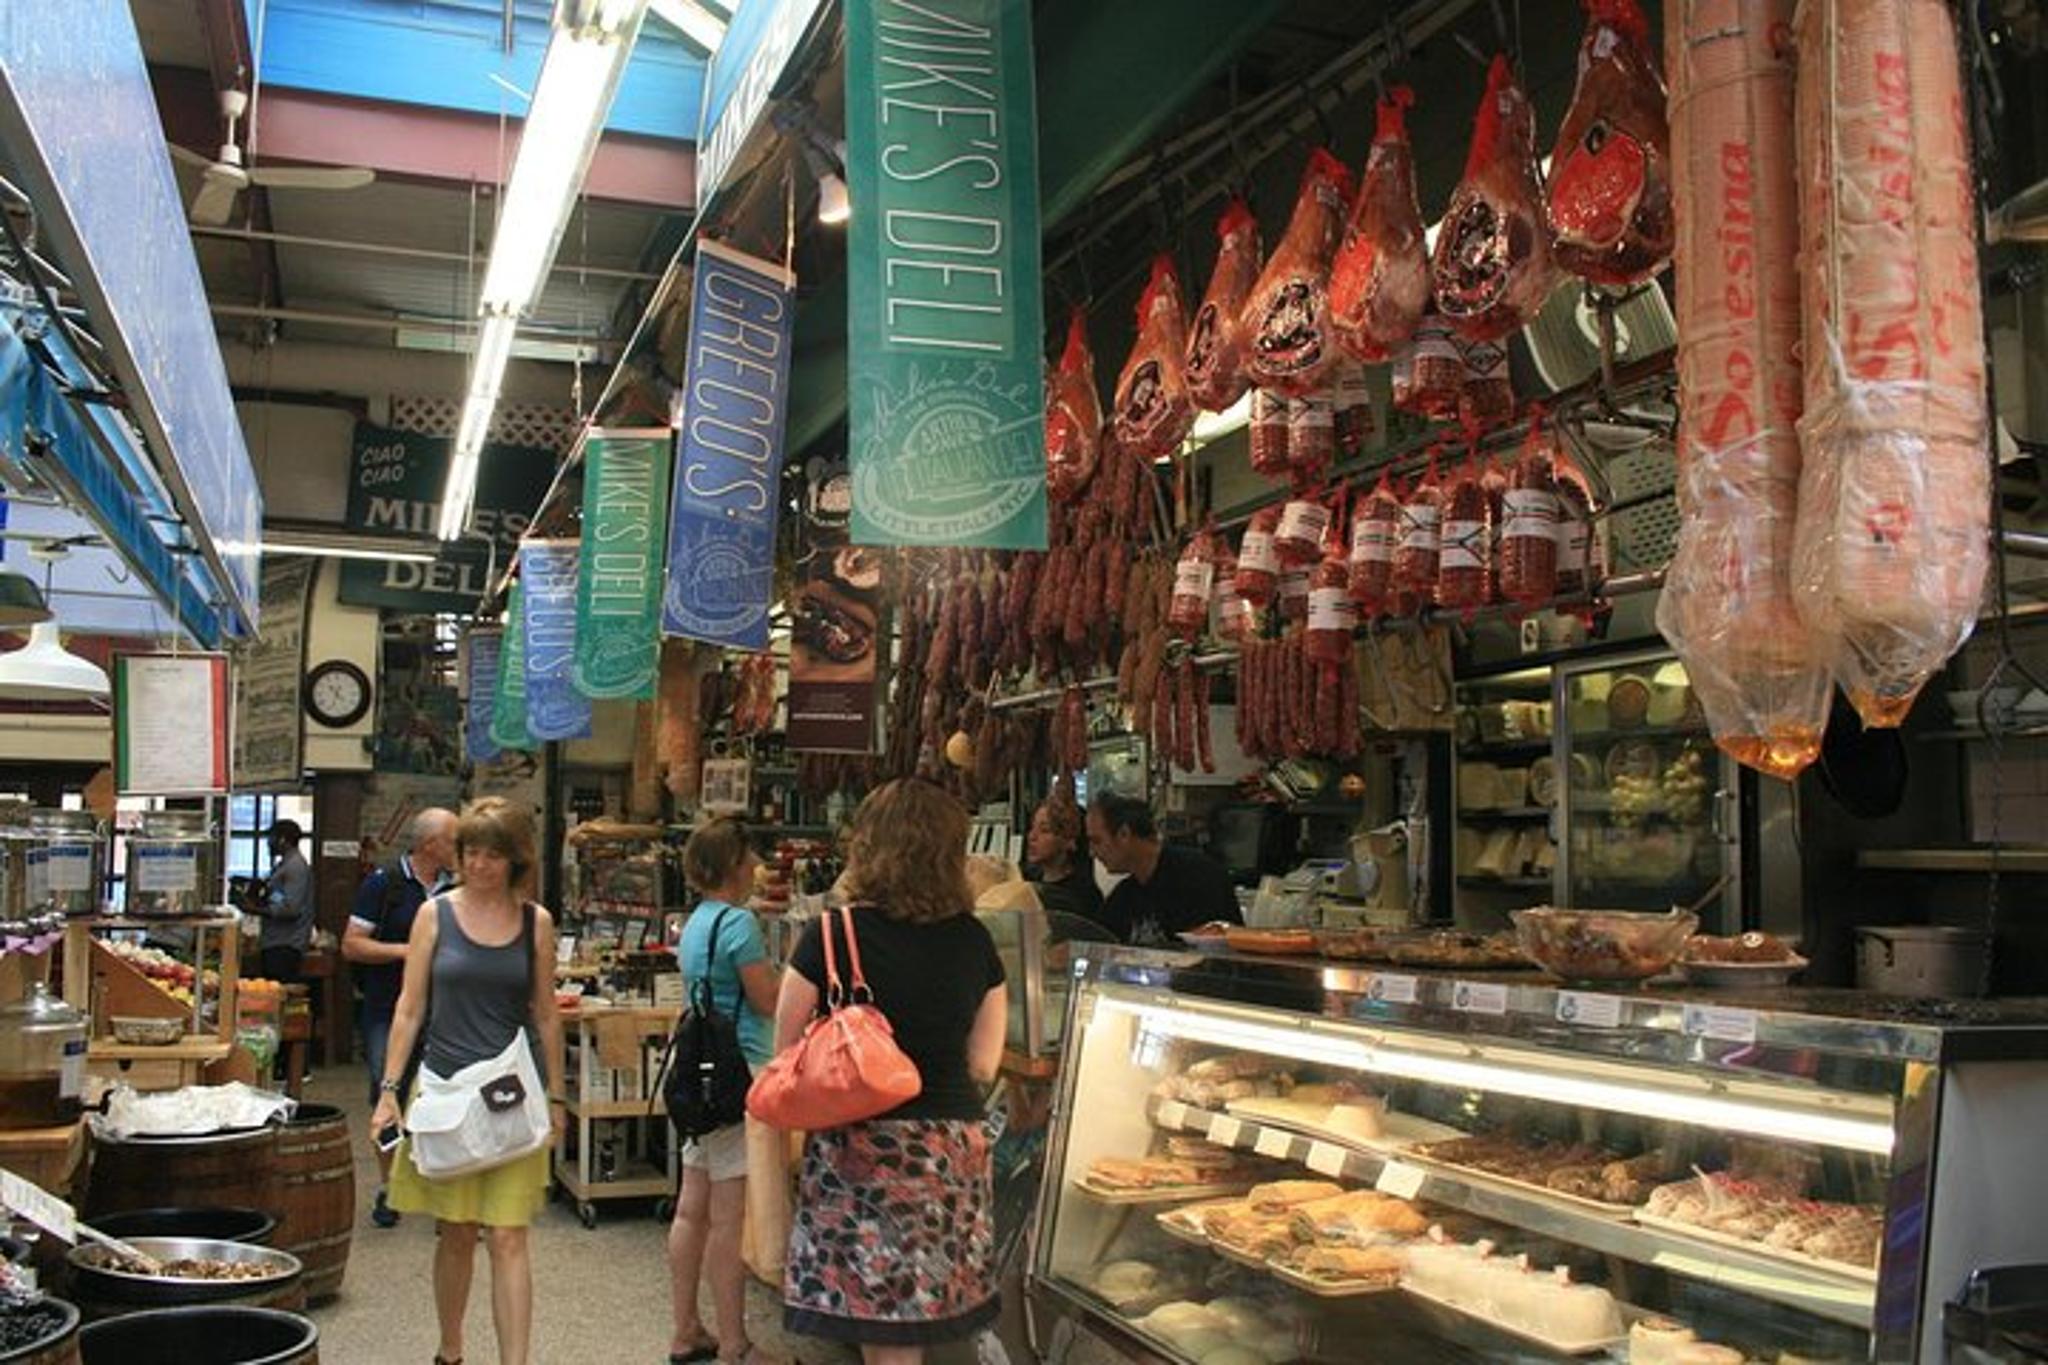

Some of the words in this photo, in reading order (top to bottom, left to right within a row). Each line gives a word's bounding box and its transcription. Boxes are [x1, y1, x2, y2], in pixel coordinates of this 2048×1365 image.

[886, 209, 1003, 351] DELI
[685, 271, 784, 511] GRECO'S
[361, 443, 405, 465] CIAO
[361, 466, 404, 487] CIAO
[594, 440, 651, 542] MIKE'S
[364, 497, 530, 542] MIE'S
[385, 561, 500, 597] DEL
[592, 554, 646, 615] DELI
